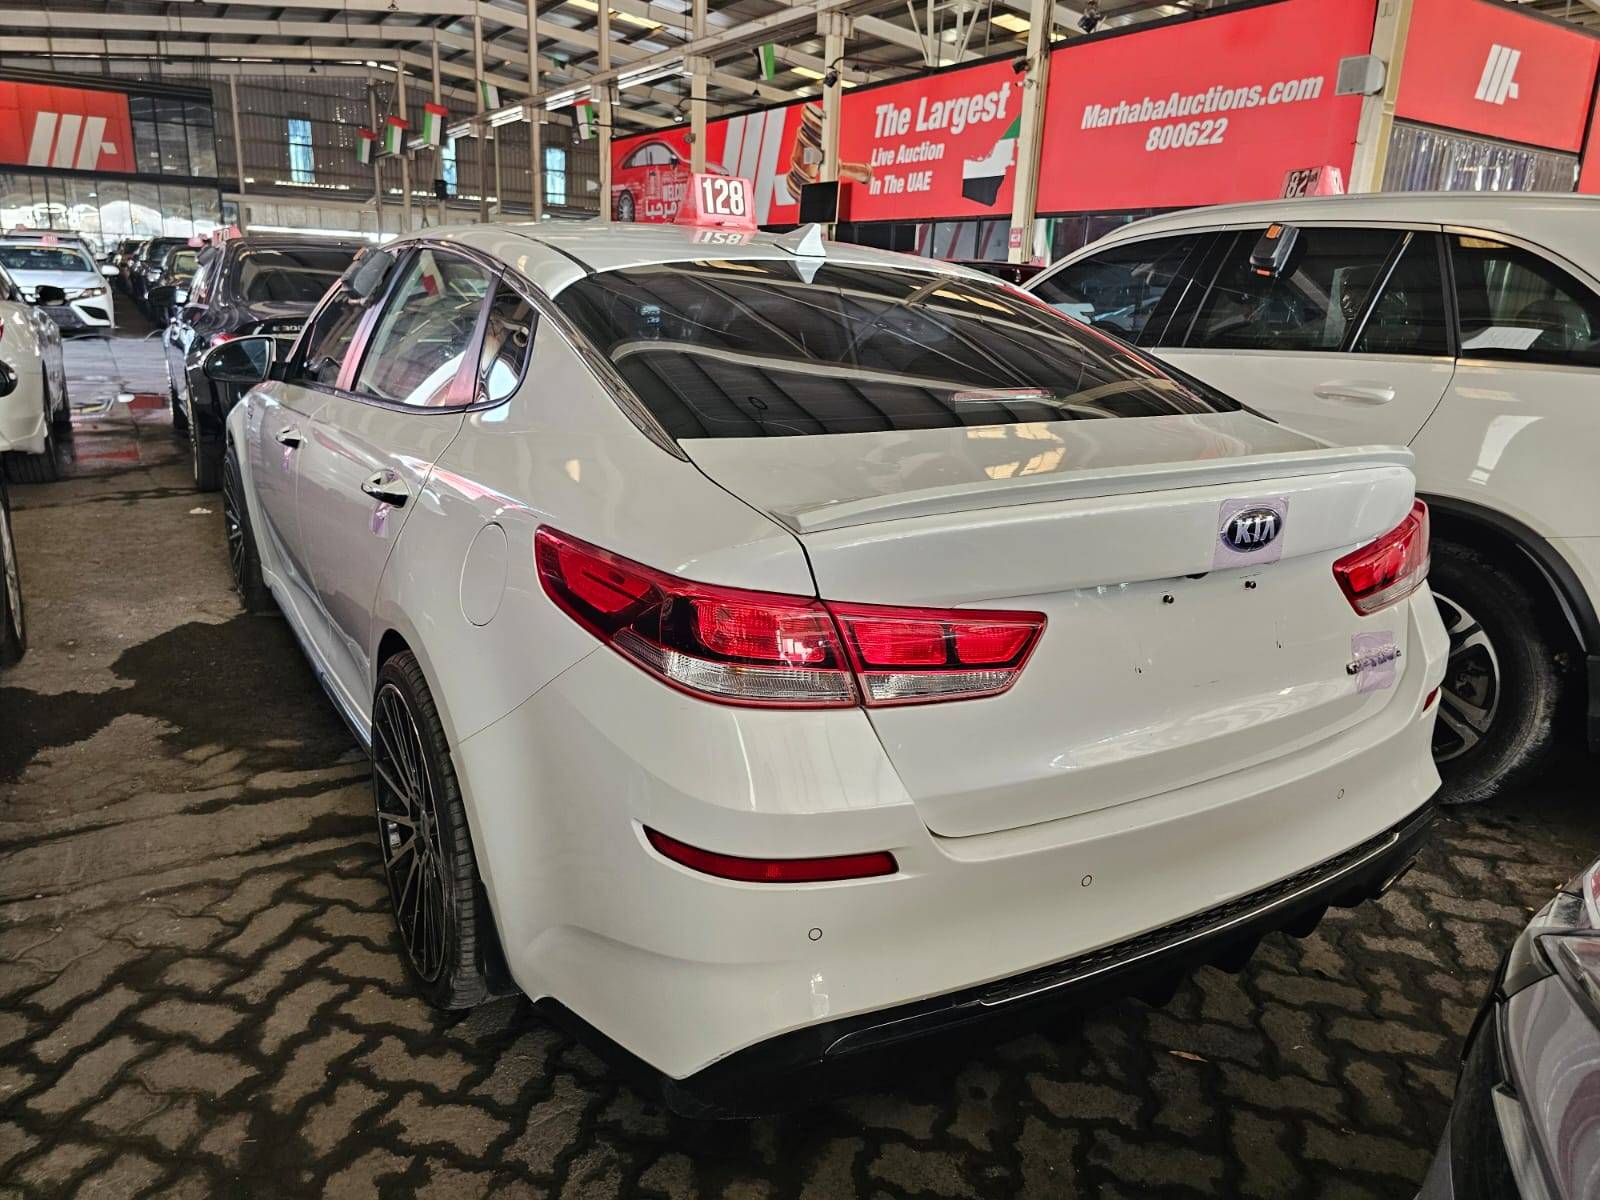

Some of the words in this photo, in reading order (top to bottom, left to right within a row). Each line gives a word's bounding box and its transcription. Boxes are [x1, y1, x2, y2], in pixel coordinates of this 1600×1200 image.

[875, 103, 912, 138] The
[915, 81, 1011, 135] Largest
[1081, 76, 1324, 129] MarhabaAuctions.com
[1145, 118, 1228, 151] 800622
[871, 147, 895, 167] Live
[896, 141, 945, 164] Auction
[702, 178, 745, 216] 128
[869, 176, 881, 195] In
[884, 175, 904, 194] The
[907, 171, 933, 193] UAE
[1235, 515, 1275, 544] KIA
